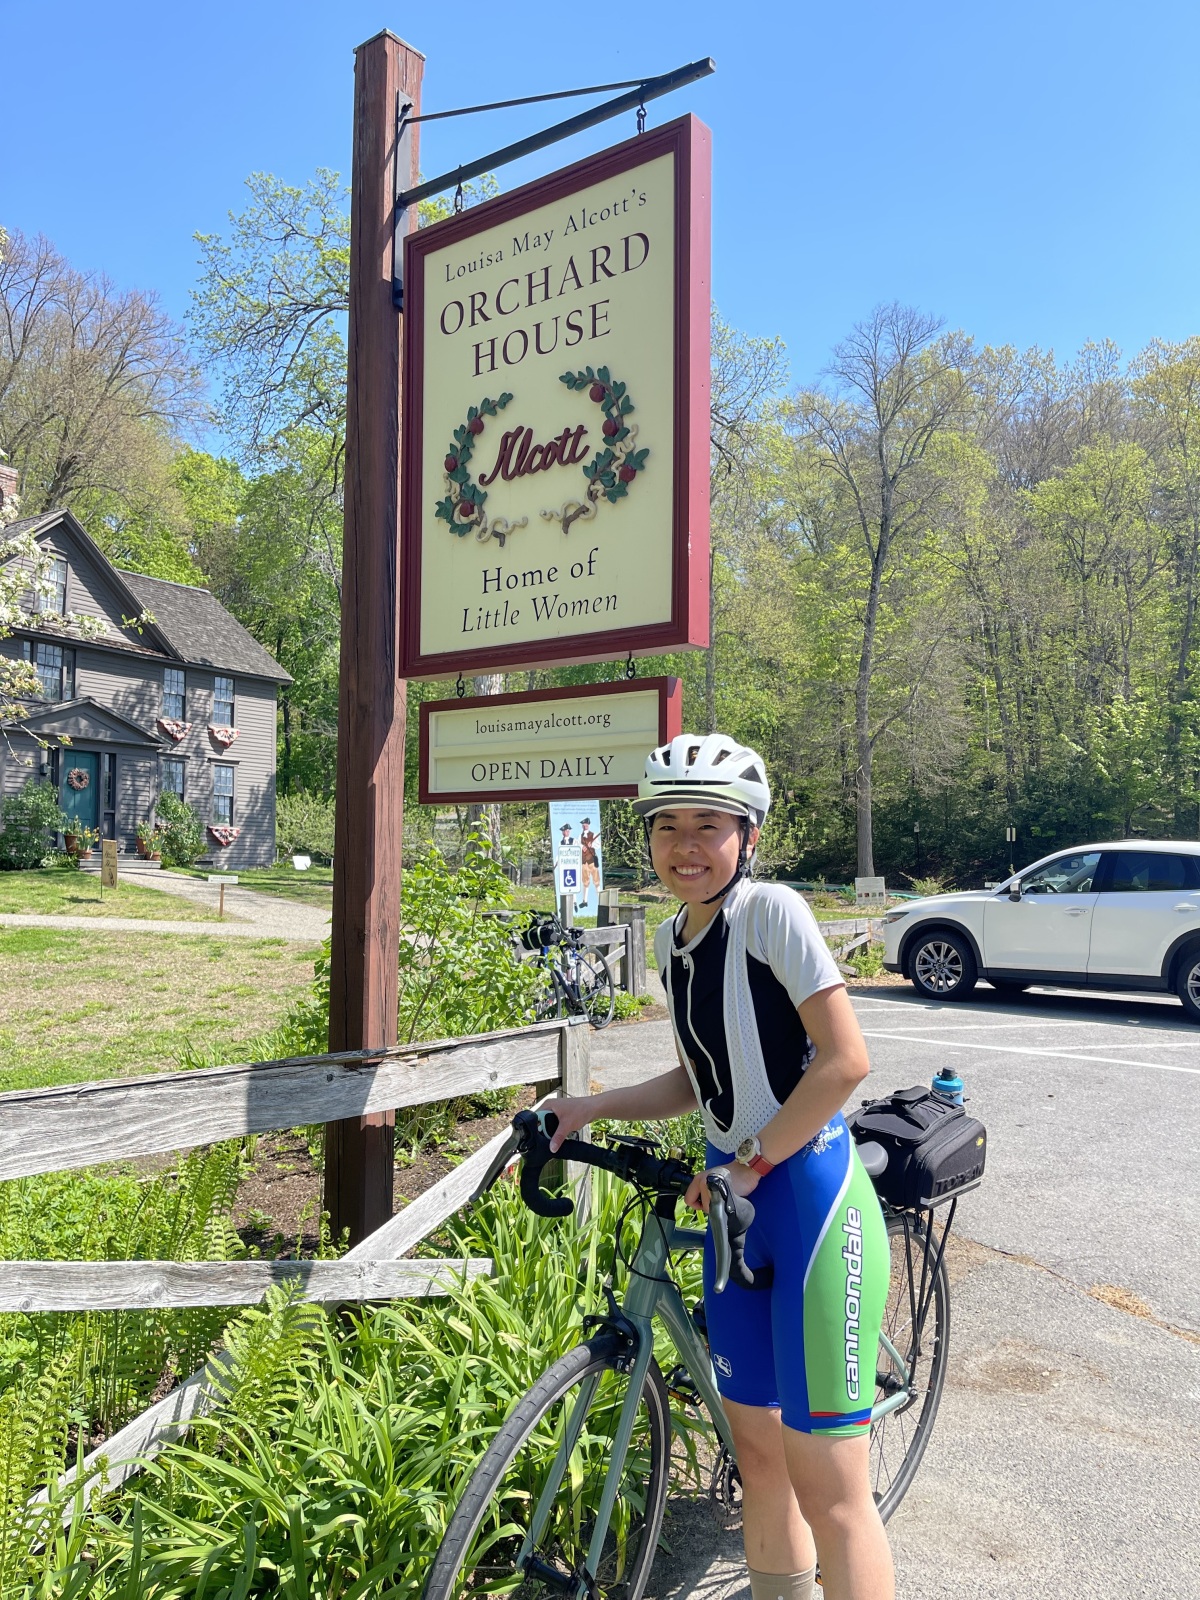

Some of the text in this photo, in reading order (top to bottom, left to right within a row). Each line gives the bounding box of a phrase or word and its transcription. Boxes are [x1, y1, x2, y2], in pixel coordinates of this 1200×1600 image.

[445, 188, 648, 283] Louisa May Alcott's
[440, 232, 650, 336] ORCHARD
[472, 299, 612, 377] HOUSE
[478, 424, 590, 487] Alcott
[482, 547, 599, 595] Home of
[461, 593, 618, 633] Little Women
[475, 712, 612, 734] louisamayalcott.org
[471, 755, 615, 782] OPEN DAILY
[935, 1161, 984, 1197] TOPEAK
[842, 1206, 864, 1401] cannondale
